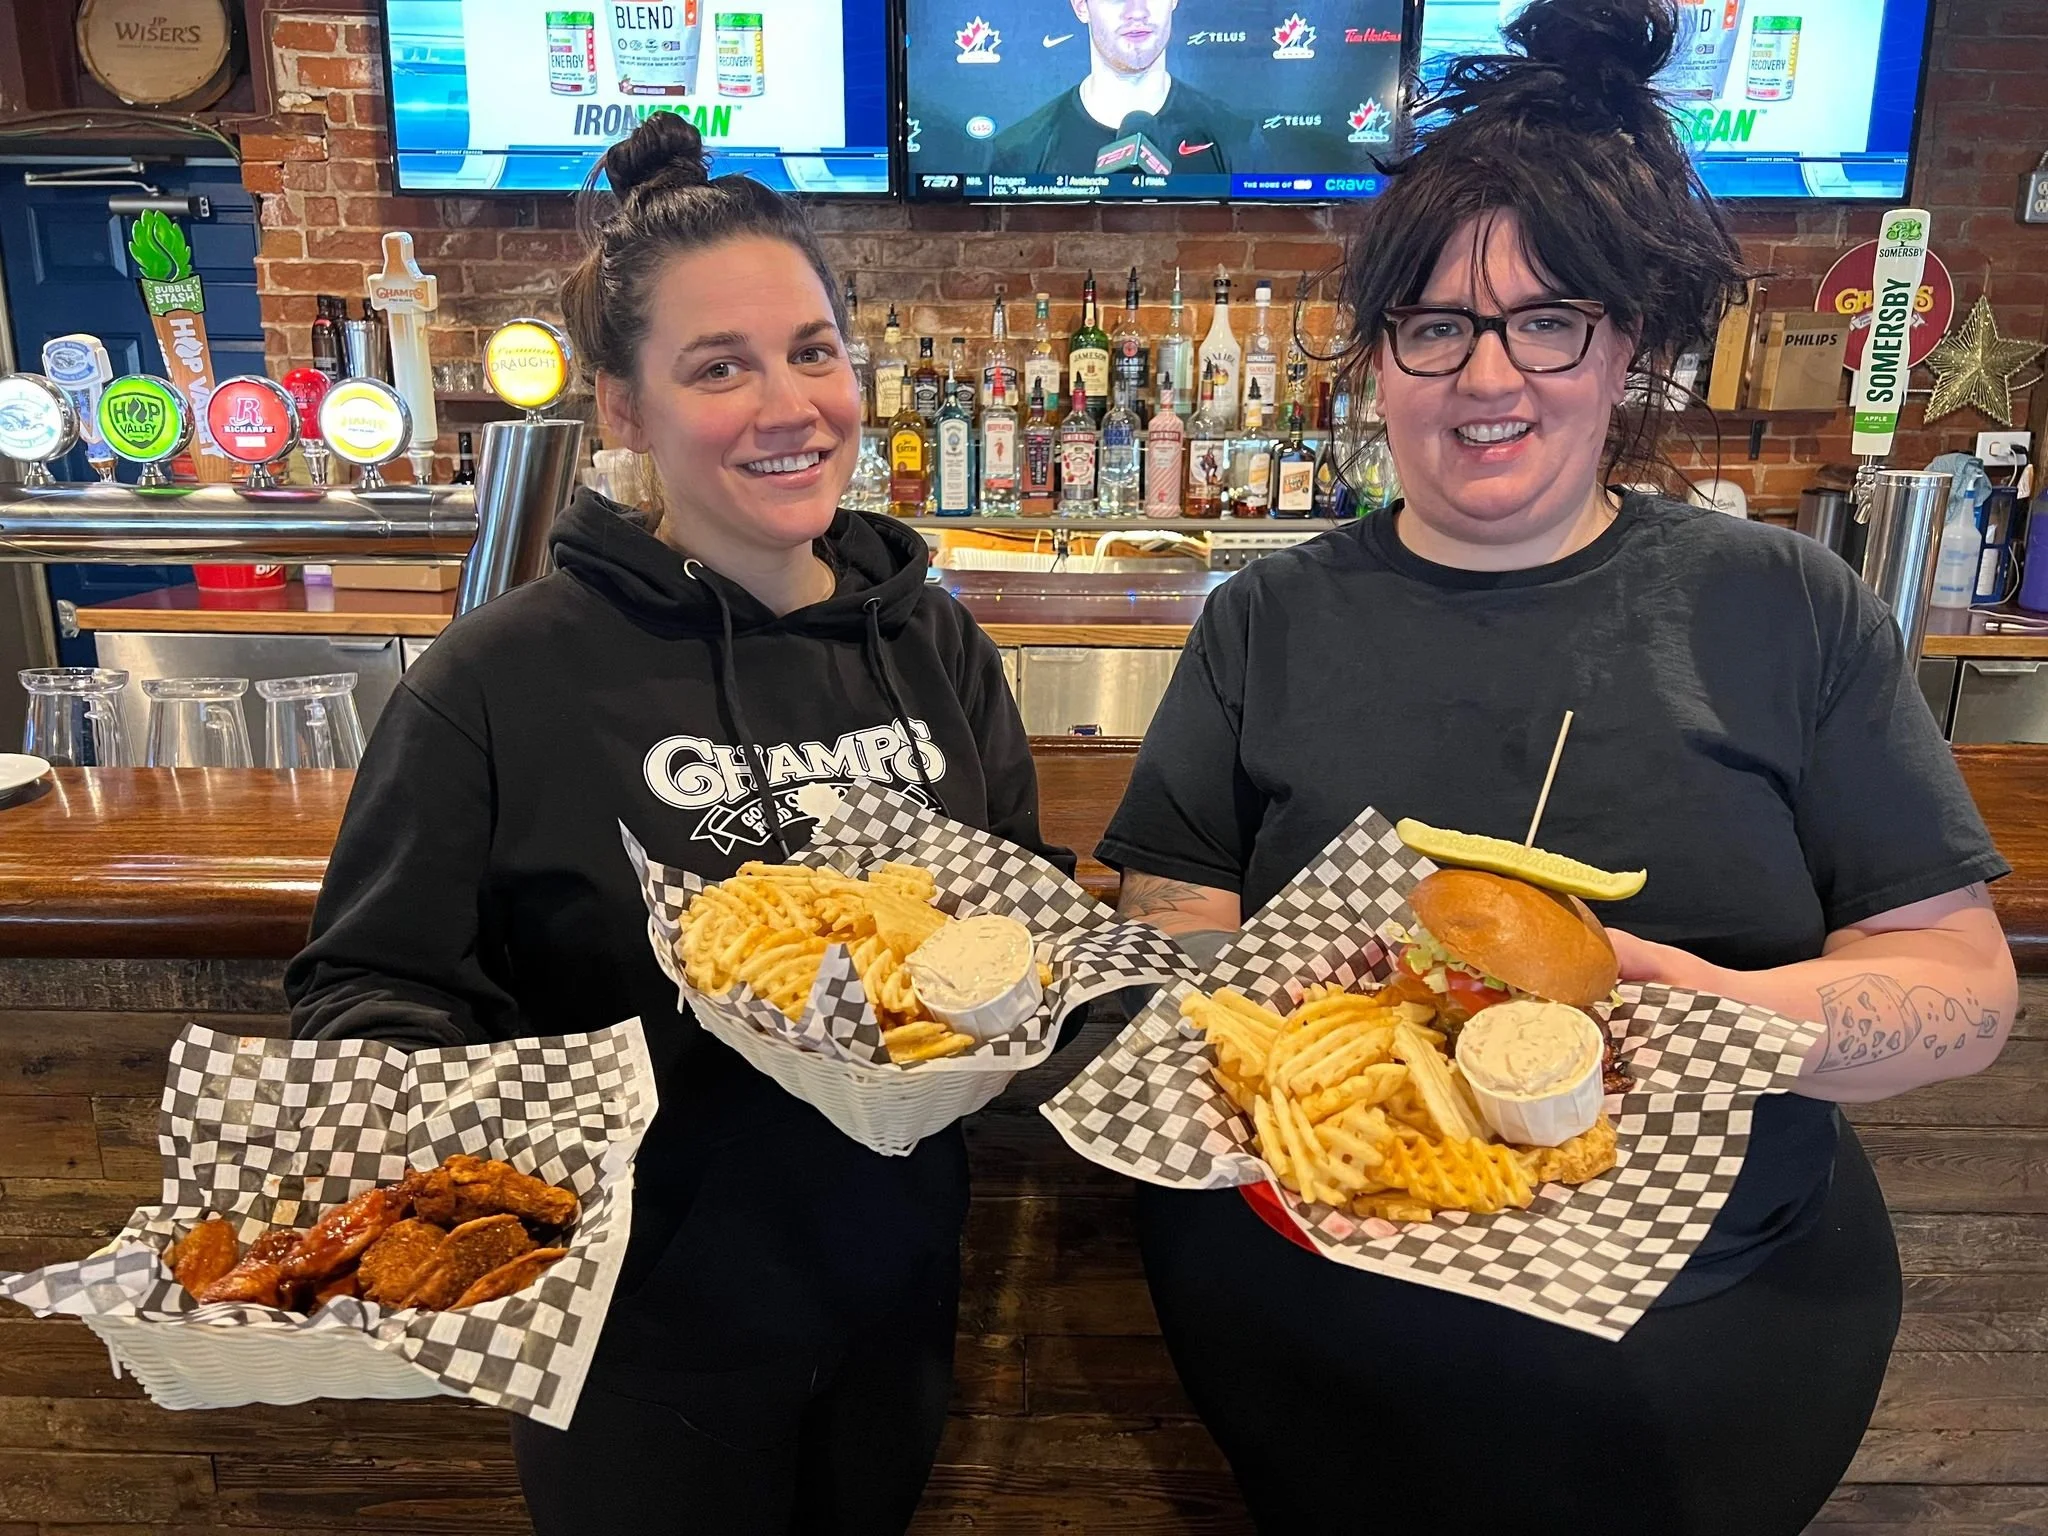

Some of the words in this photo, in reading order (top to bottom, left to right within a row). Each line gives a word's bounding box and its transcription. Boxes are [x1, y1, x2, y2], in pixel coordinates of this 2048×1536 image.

[149, 16, 168, 27] JP
[615, 6, 673, 29] BLEND
[115, 21, 201, 44] WISER'S
[1209, 31, 1246, 42] TELUS
[552, 54, 584, 68] ENERGY
[719, 56, 753, 68] RECOVERY
[1751, 59, 1786, 71] RECOVERY
[573, 104, 731, 138] IRONAN
[1285, 115, 1321, 126] TELUS
[922, 175, 958, 188] TSN
[1878, 247, 1925, 259] SOMERSBY
[154, 284, 193, 294] BUBBLE
[376, 287, 424, 300] CHAMPS
[155, 292, 196, 305] STASH
[1834, 284, 1935, 315] CHS
[1784, 334, 1838, 346] PHILIPS
[1866, 278, 1912, 403] SOMERSBY
[1073, 352, 1107, 362] JAMESON
[491, 356, 557, 373] DRAUGHT
[119, 424, 157, 435] VALLEY
[643, 717, 946, 809] CHAMPS
